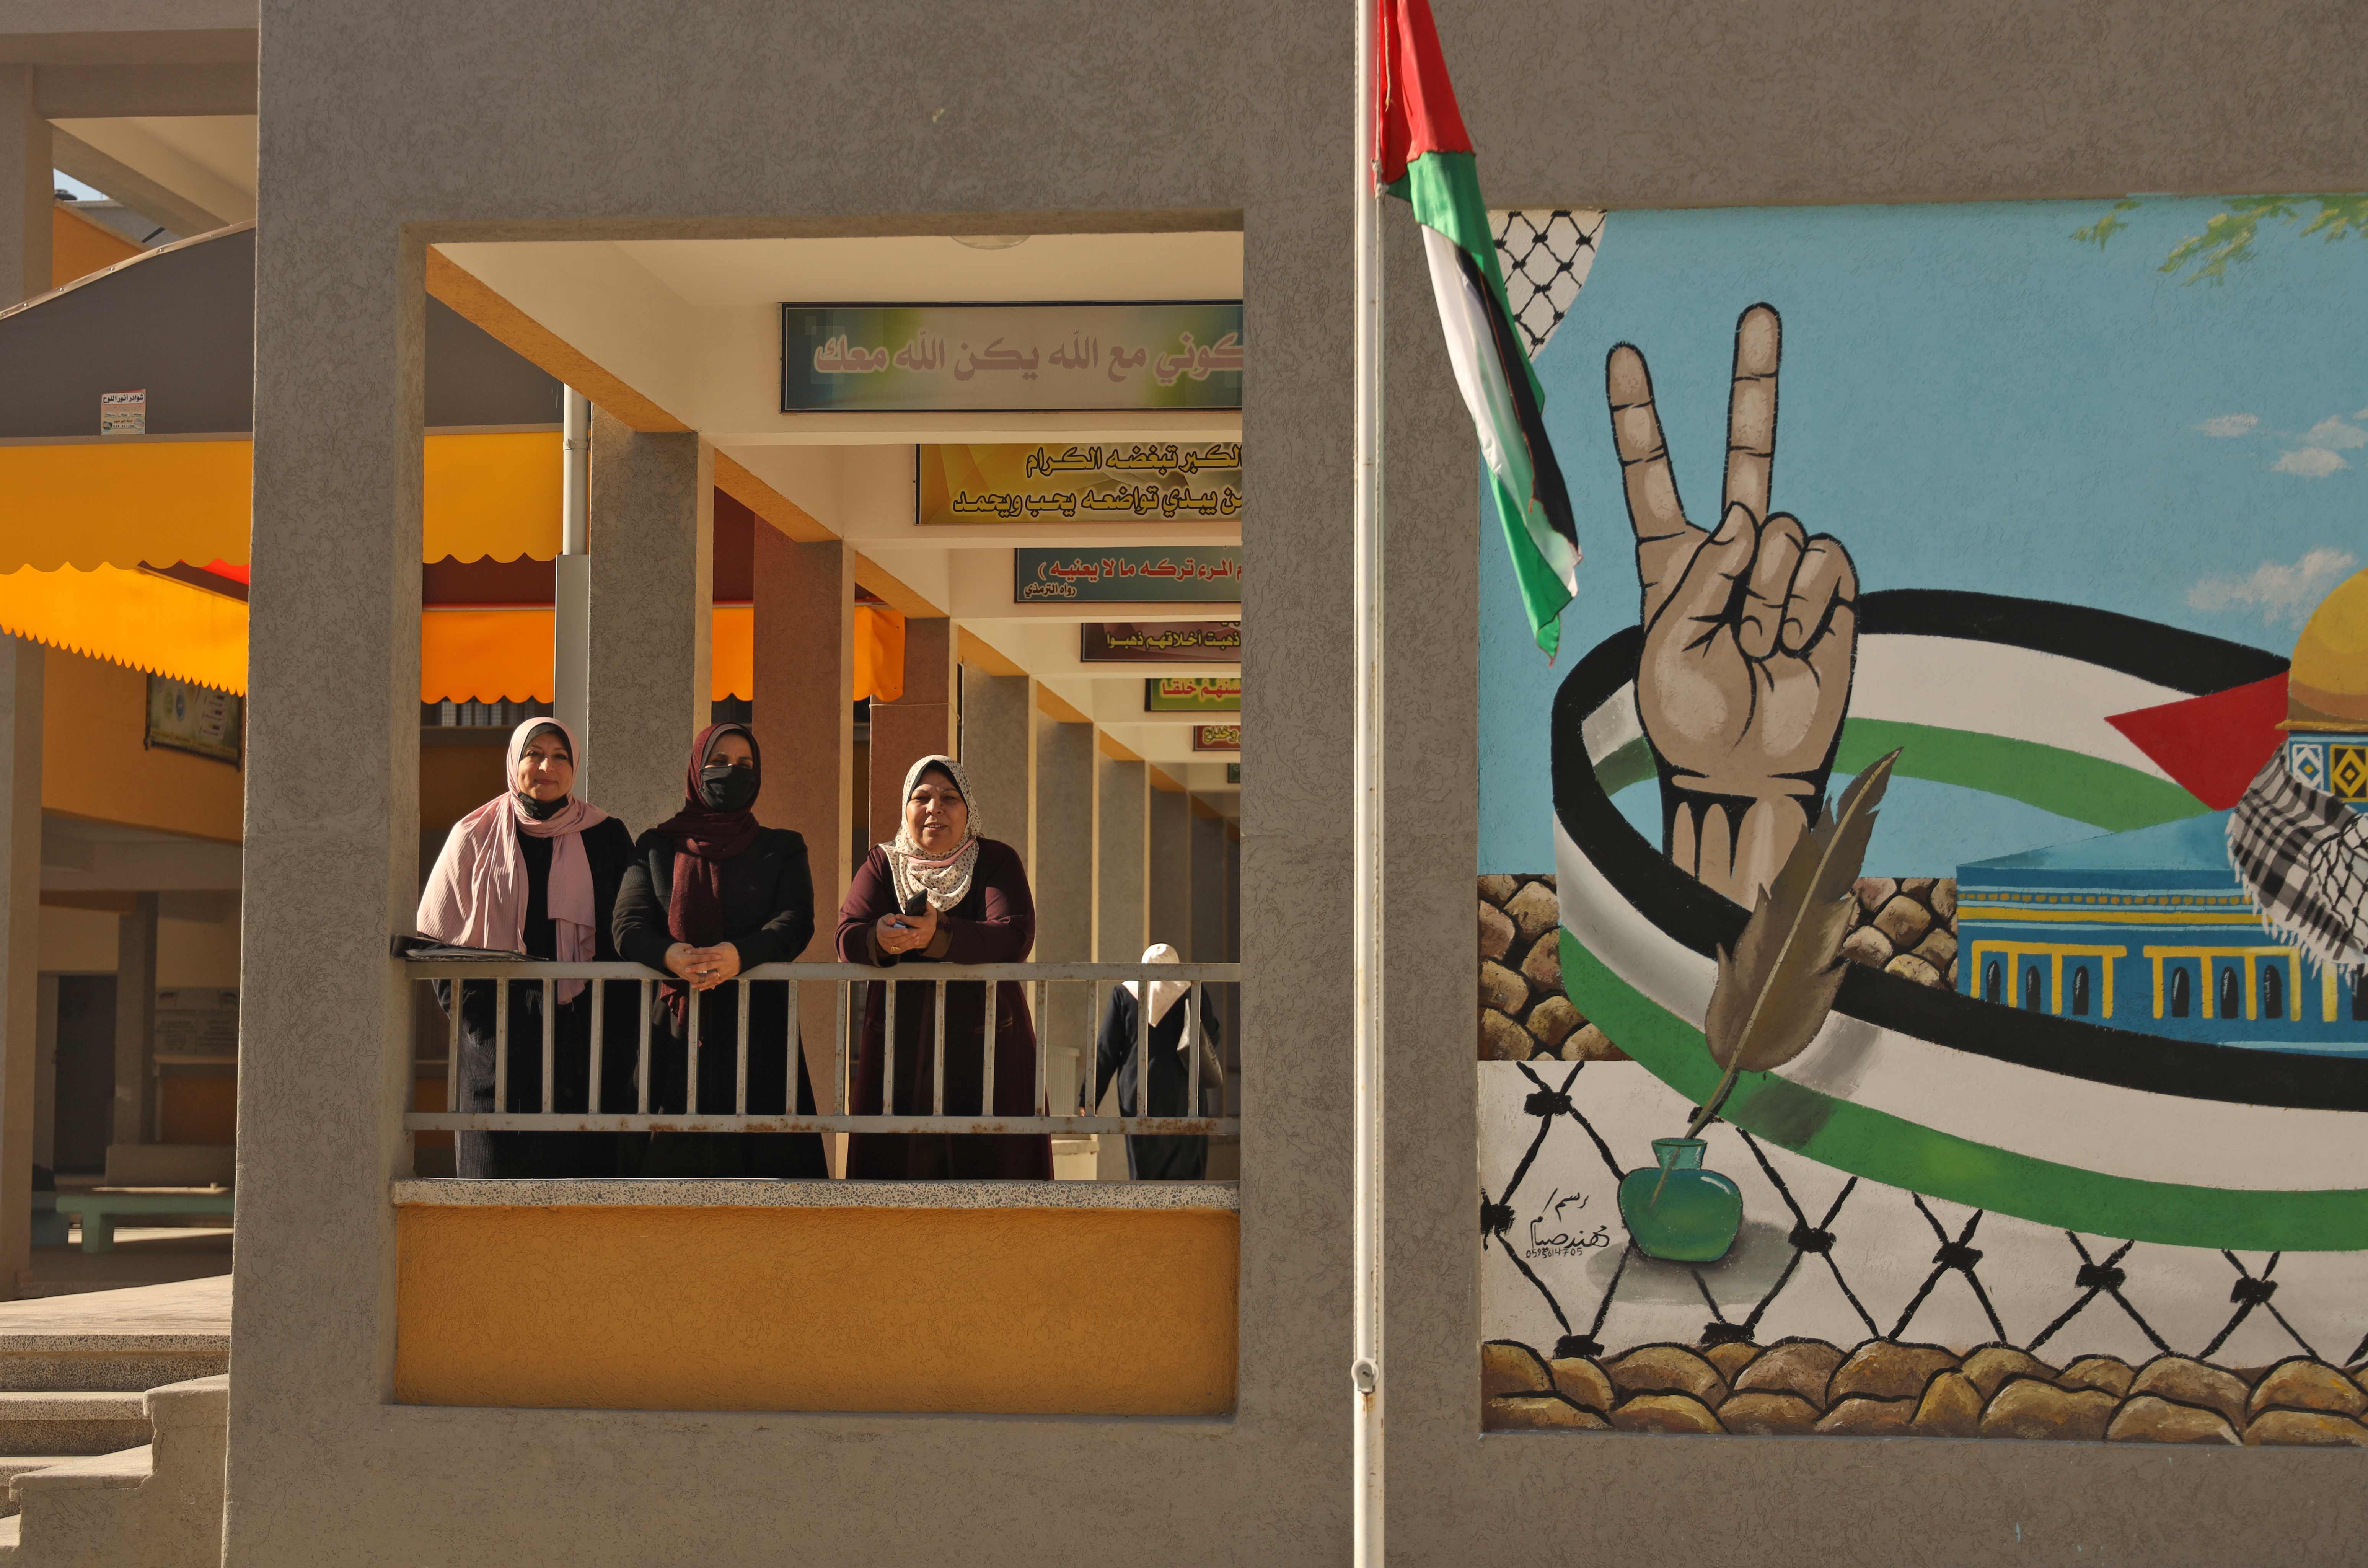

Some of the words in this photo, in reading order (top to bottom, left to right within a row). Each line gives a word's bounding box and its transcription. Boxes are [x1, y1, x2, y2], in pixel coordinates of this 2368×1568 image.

[817, 335, 887, 370] معك
[893, 328, 945, 370] الله
[954, 337, 1039, 381] يكن
[1049, 329, 1098, 369] الله
[1108, 346, 1146, 382] مع
[129, 393, 143, 402] شوادر
[1026, 447, 1101, 478] الكرام
[1106, 445, 1179, 476] تبغضه
[1178, 444, 1242, 474] لكبر
[953, 491, 1022, 518] ويحمد
[1026, 492, 1075, 518] يحب
[1082, 485, 1159, 515] تواضعه
[1163, 491, 1217, 518] يبدي
[1050, 559, 1098, 581] يعنيه
[1102, 558, 1115, 577] لا
[1120, 559, 1134, 577] ما
[1139, 559, 1195, 580] تركه
[1198, 559, 1232, 580] المرء
[1025, 582, 1058, 598] الترمذي
[1060, 583, 1076, 596] رواه
[1107, 632, 1144, 649] ذهبوا
[1146, 630, 1202, 650] أخلاقهم
[1204, 631, 1241, 650] ذهبت
[1162, 680, 1196, 694] خلقا
